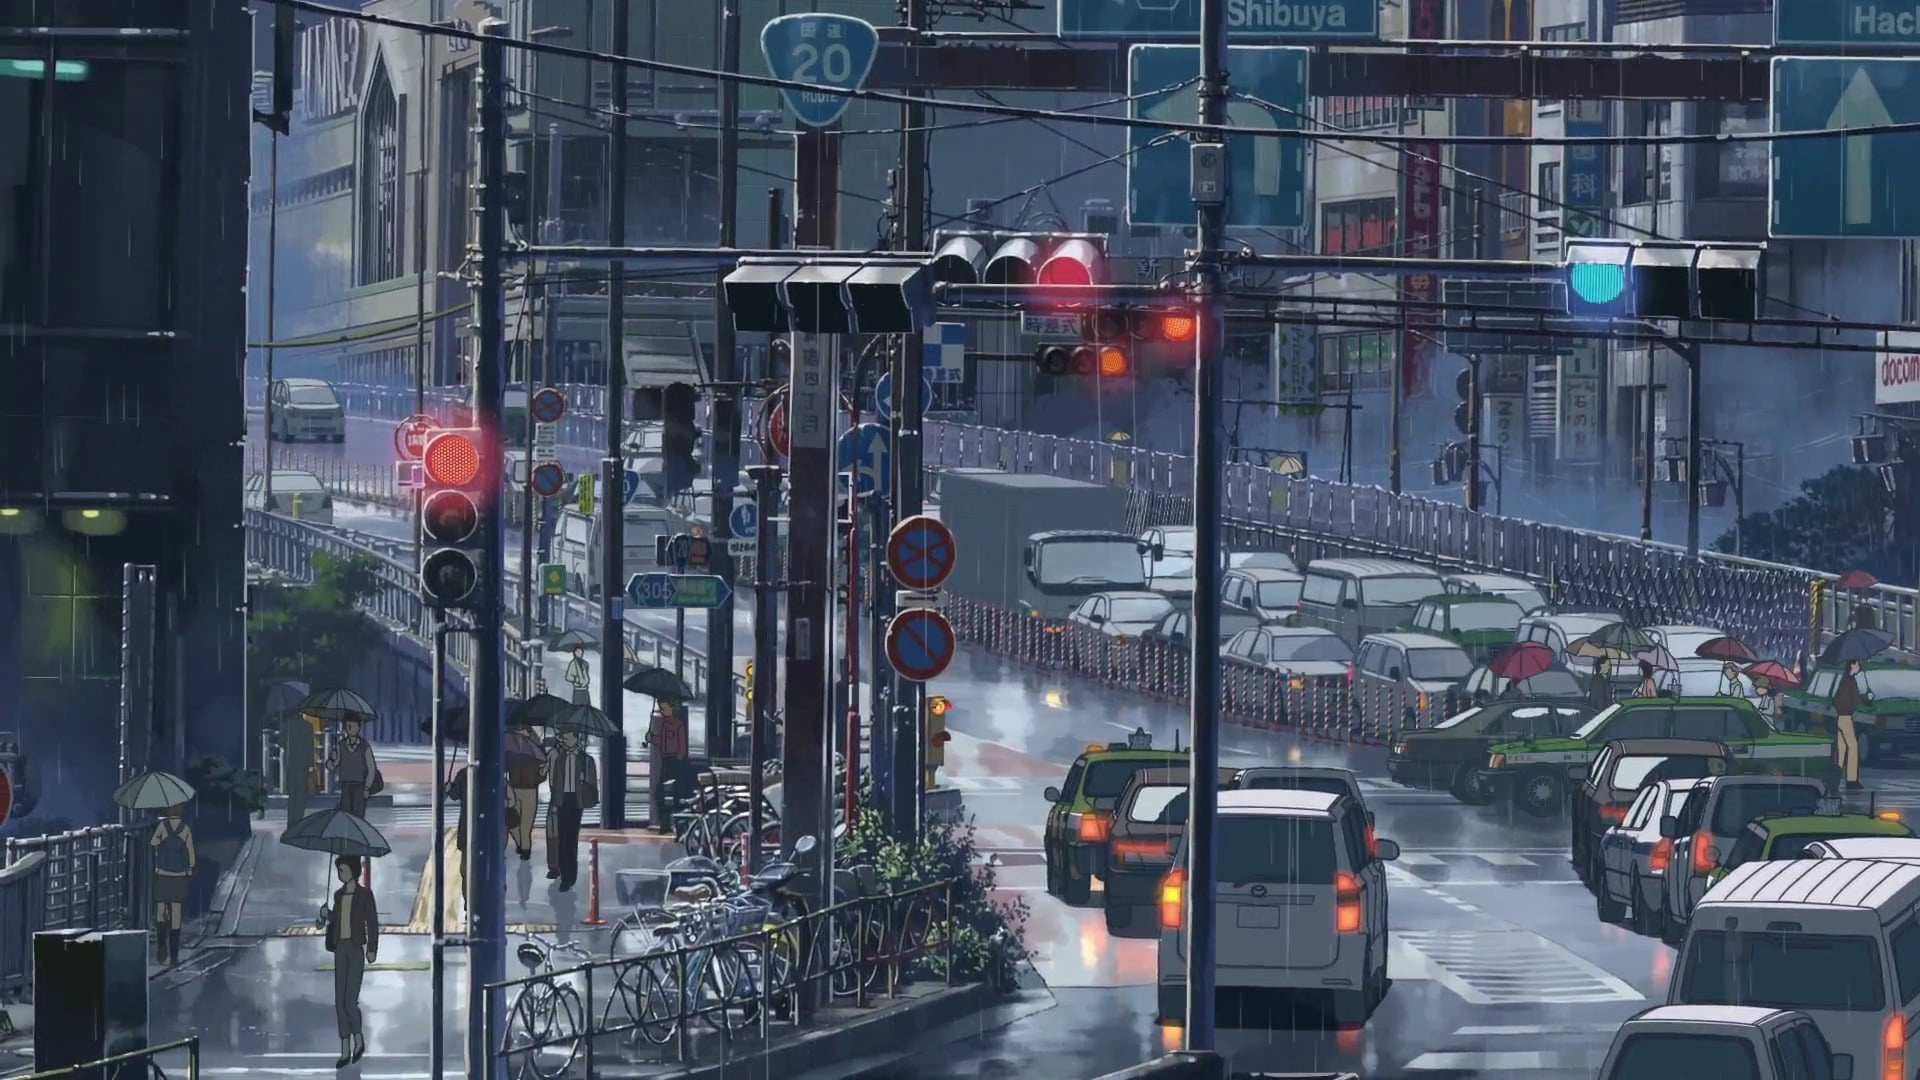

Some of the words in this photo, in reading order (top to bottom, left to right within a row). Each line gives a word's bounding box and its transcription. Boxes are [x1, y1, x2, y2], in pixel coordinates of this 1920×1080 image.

[1227, 0, 1346, 31] Shibuya
[792, 43, 851, 83] 20
[641, 582, 672, 600] 305
